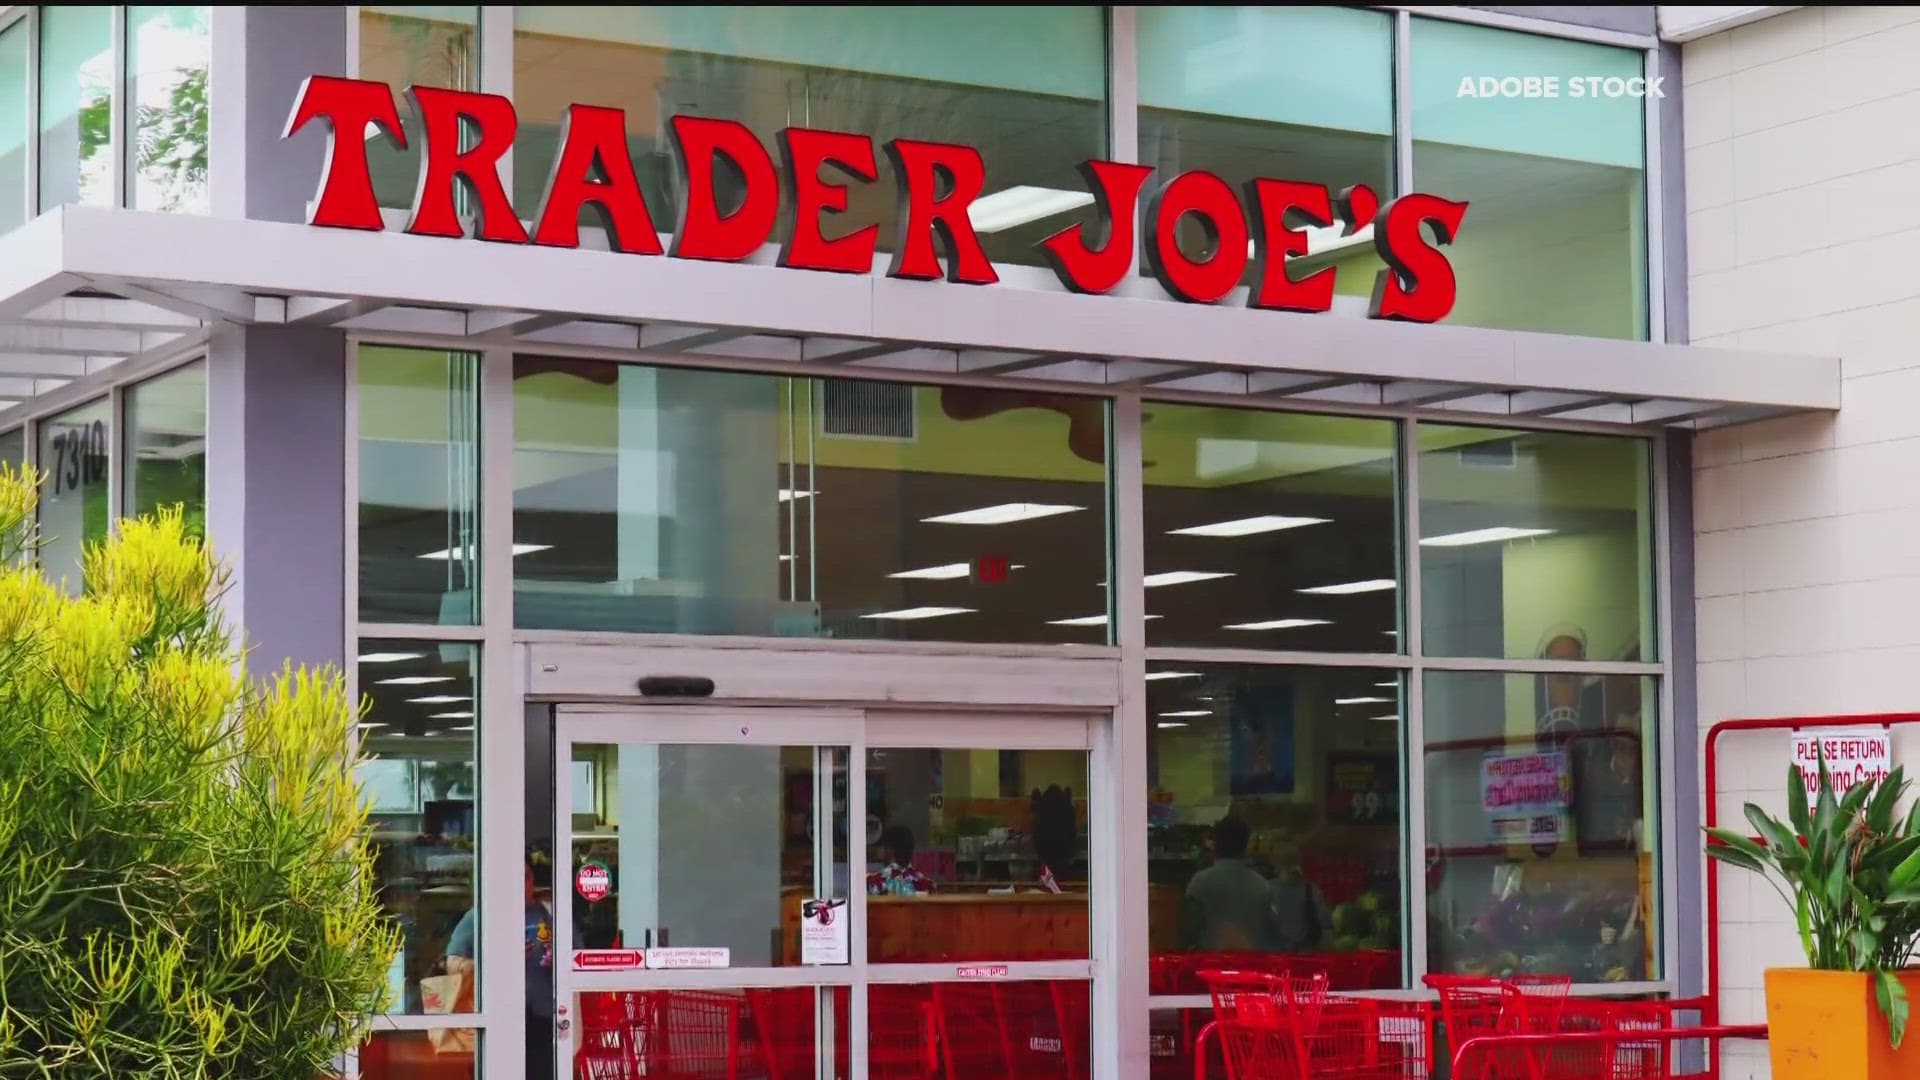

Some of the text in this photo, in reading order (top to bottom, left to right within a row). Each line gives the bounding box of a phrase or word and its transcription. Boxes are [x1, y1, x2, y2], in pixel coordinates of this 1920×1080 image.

[281, 75, 1469, 324] TRADER JOE'S
[53, 420, 104, 494] 7310
[1797, 739, 1885, 761] PLESE RETURN
